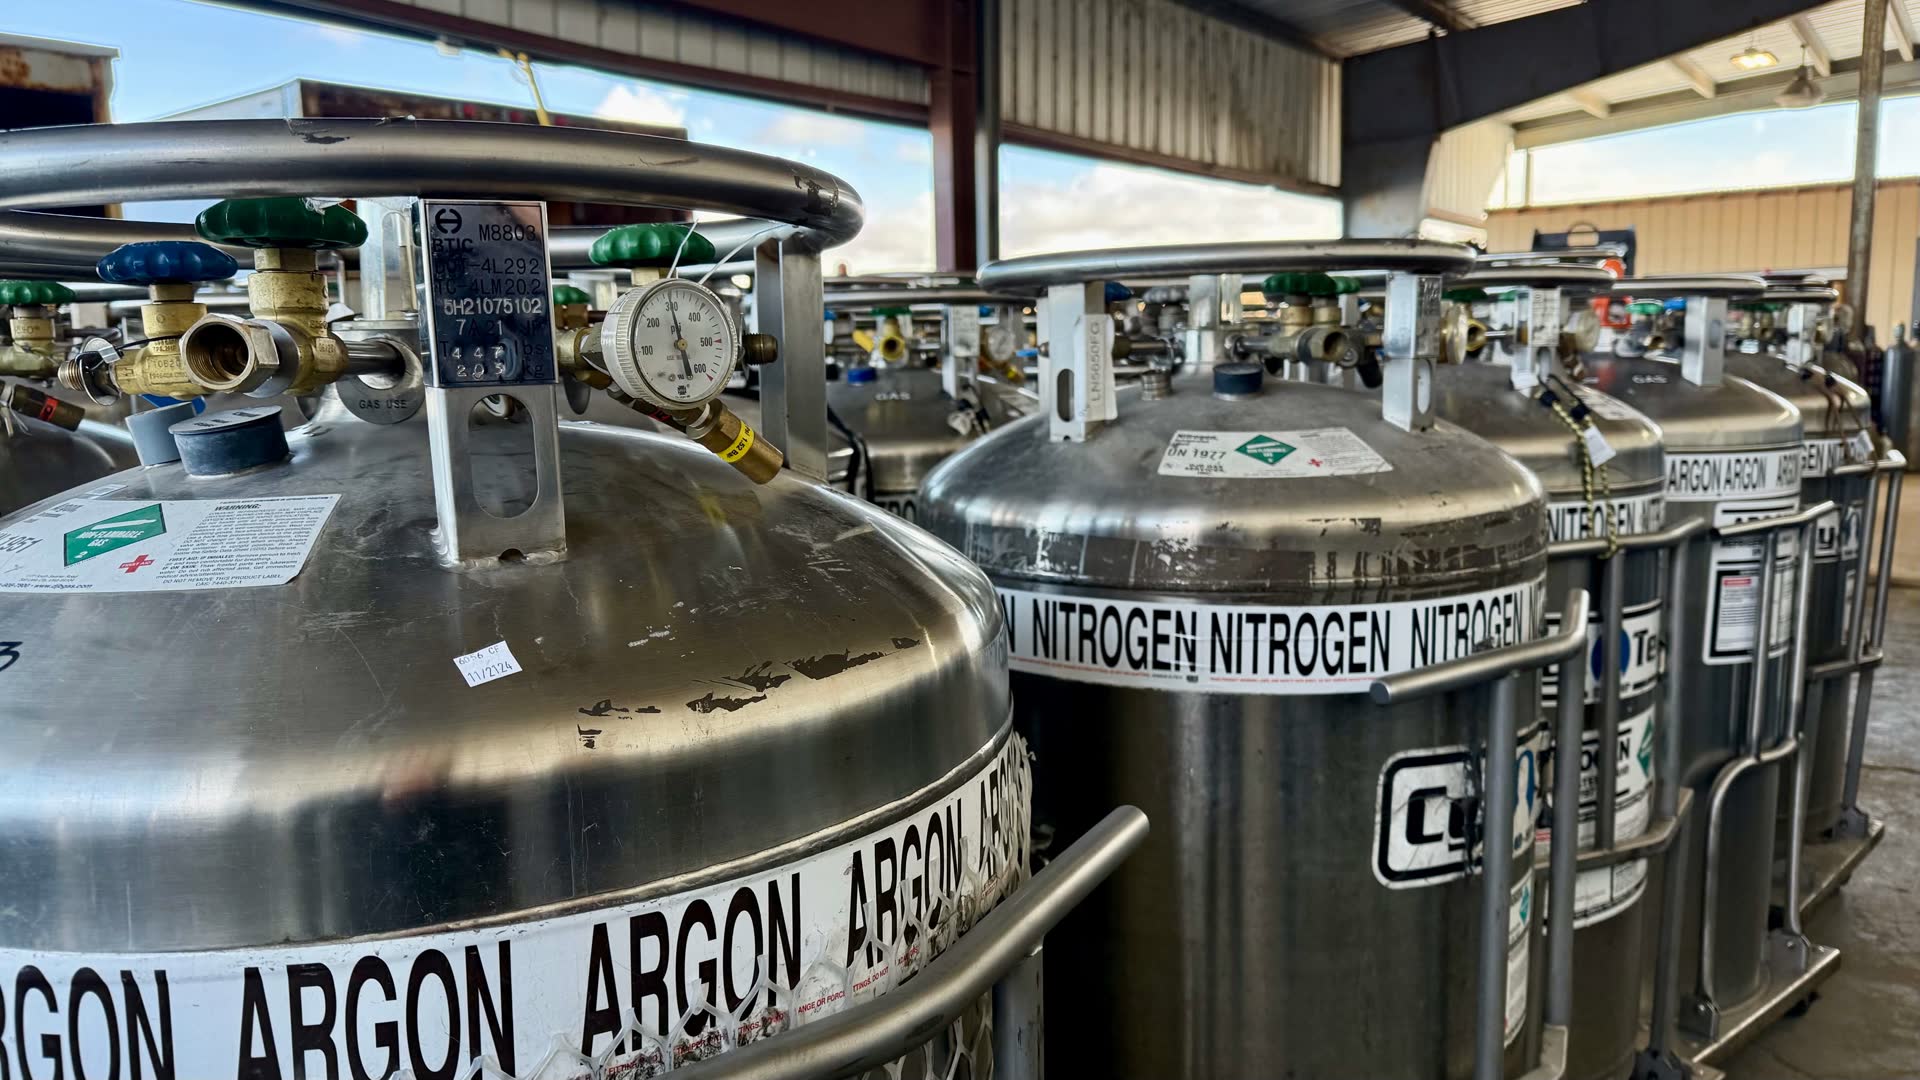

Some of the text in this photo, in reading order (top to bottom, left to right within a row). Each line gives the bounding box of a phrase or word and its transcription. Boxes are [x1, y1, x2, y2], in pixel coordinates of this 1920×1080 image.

[479, 223, 536, 242] M8803
[433, 238, 474, 253] BTIC
[444, 297, 542, 316] 5H21075102
[646, 317, 660, 328] 200
[688, 311, 702, 323] 400
[670, 322, 682, 335] pi
[700, 336, 713, 348] 500
[641, 345, 654, 356] 100
[693, 363, 707, 374] 600
[359, 399, 408, 409] GAS USE
[1167, 447, 1227, 461] UN 1977
[1667, 456, 1723, 493] ARGON
[1724, 454, 1768, 490] ARGON
[87, 538, 110, 547] GAS
[1031, 597, 1198, 673] NITROGEN
[1210, 609, 1391, 677] NITROGEN
[1411, 589, 1524, 670] NITROGEN
[1633, 629, 1657, 667] Te
[0, 963, 176, 1080] GON
[237, 939, 517, 1080] ARGON
[581, 871, 802, 1057] ARGON
[846, 797, 964, 969] ARGON
[798, 1001, 816, 1014] ANGE
[816, 998, 826, 1008] OR
